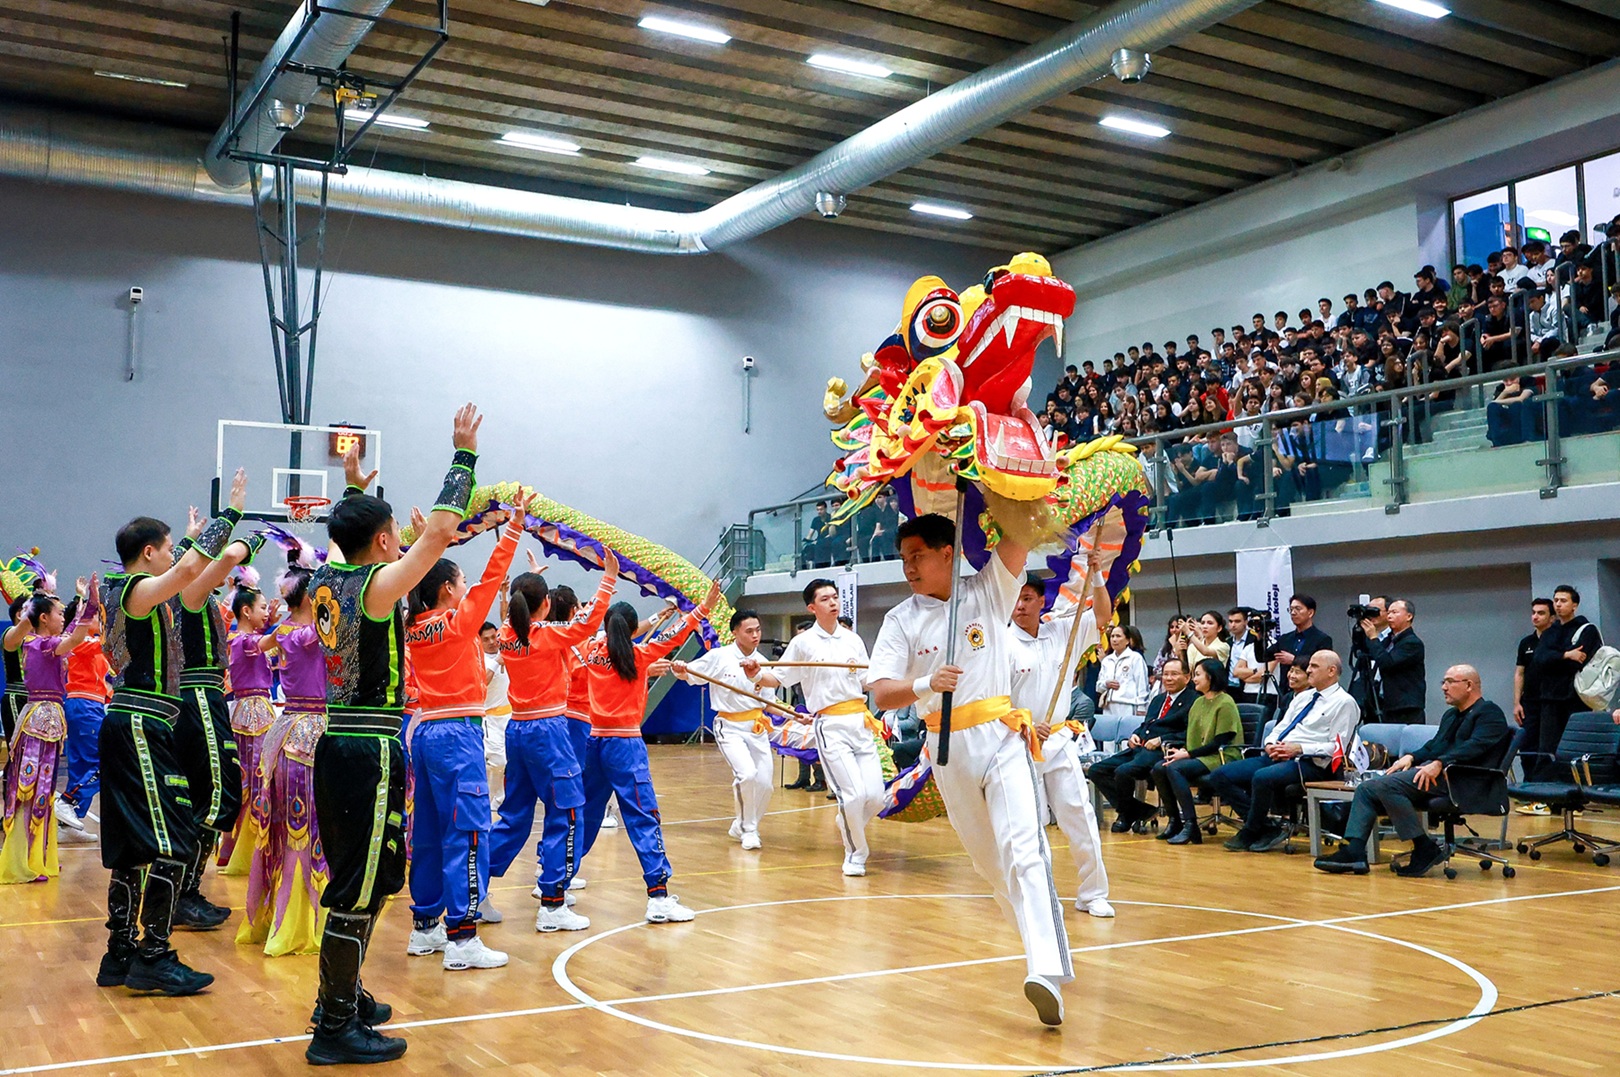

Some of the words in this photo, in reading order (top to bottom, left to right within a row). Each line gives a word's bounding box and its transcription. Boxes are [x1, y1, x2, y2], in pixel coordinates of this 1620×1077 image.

[1272, 583, 1280, 614] koleji
[566, 824, 576, 858] ENERGY
[468, 849, 477, 888] ENERGY
[467, 893, 478, 919] ERGY
